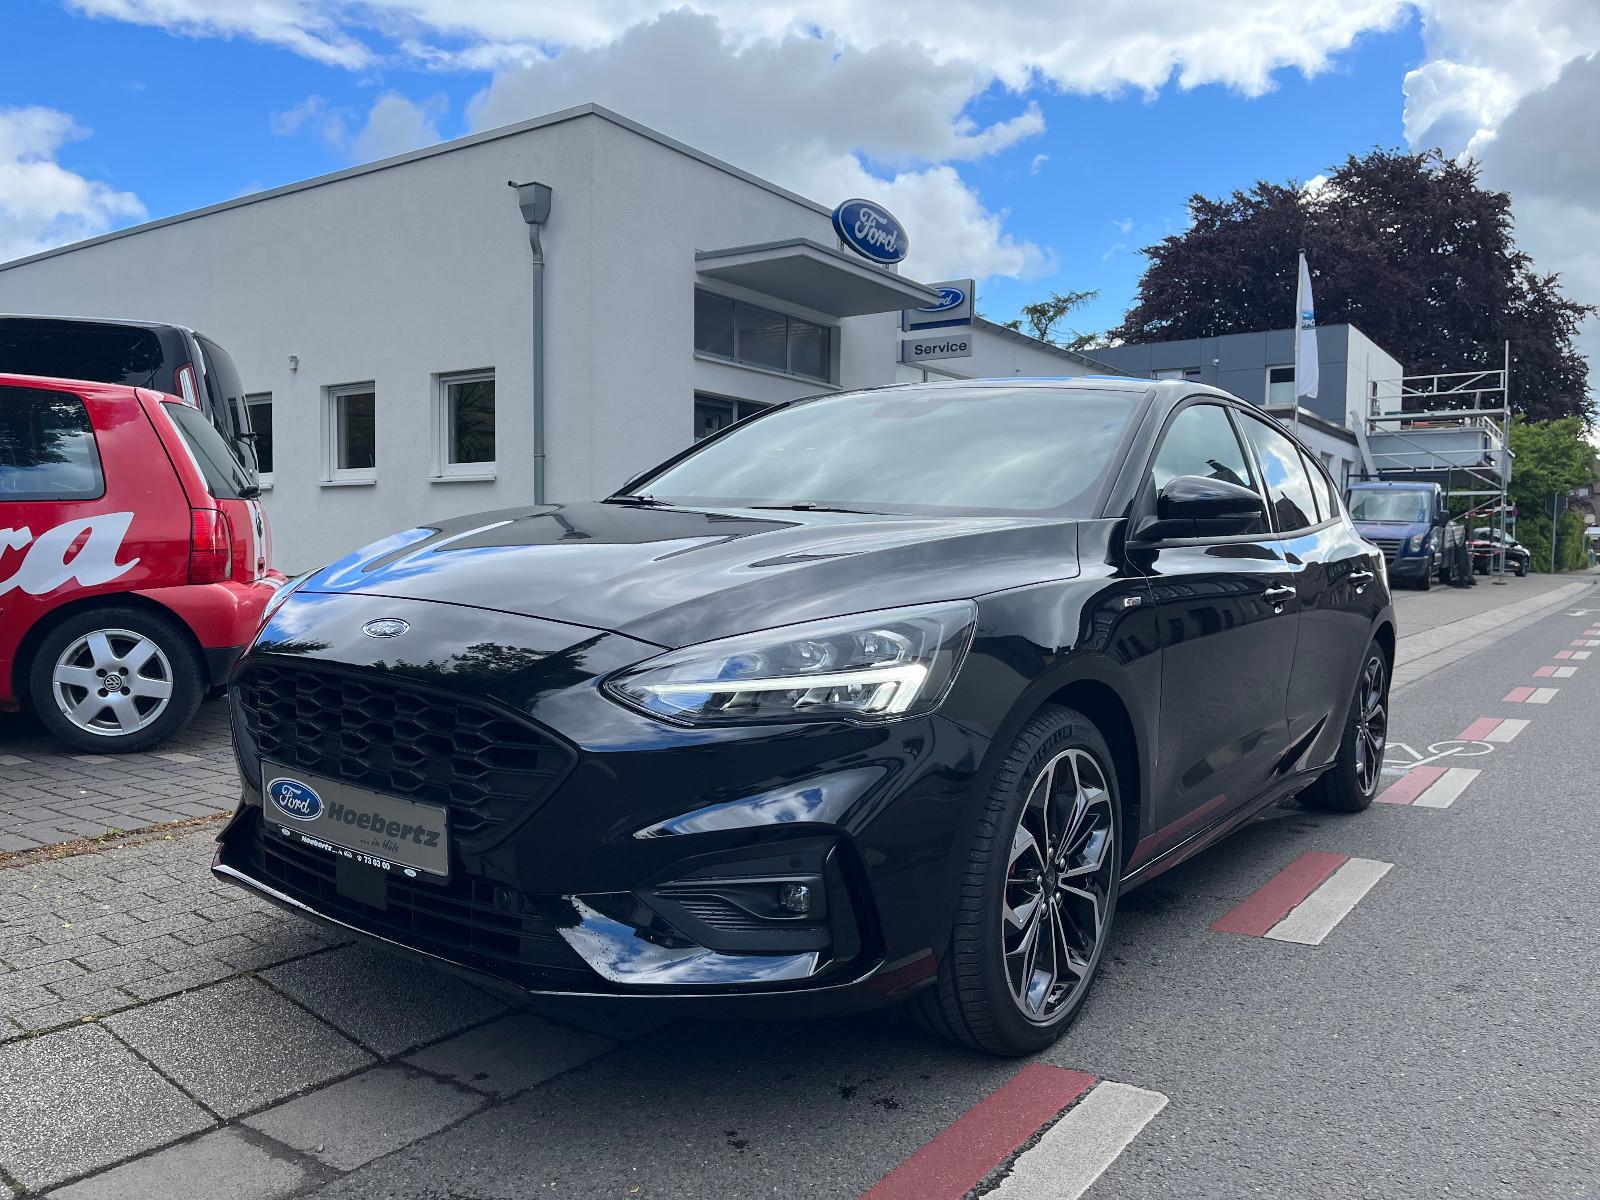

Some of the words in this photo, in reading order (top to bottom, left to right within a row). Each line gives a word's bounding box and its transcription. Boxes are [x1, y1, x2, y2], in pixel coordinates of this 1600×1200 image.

[854, 207, 898, 253] Ford
[914, 341, 968, 356] Service
[279, 784, 310, 814] Ford
[327, 801, 441, 848] Hoebertz
[363, 855, 372, 865] 73
